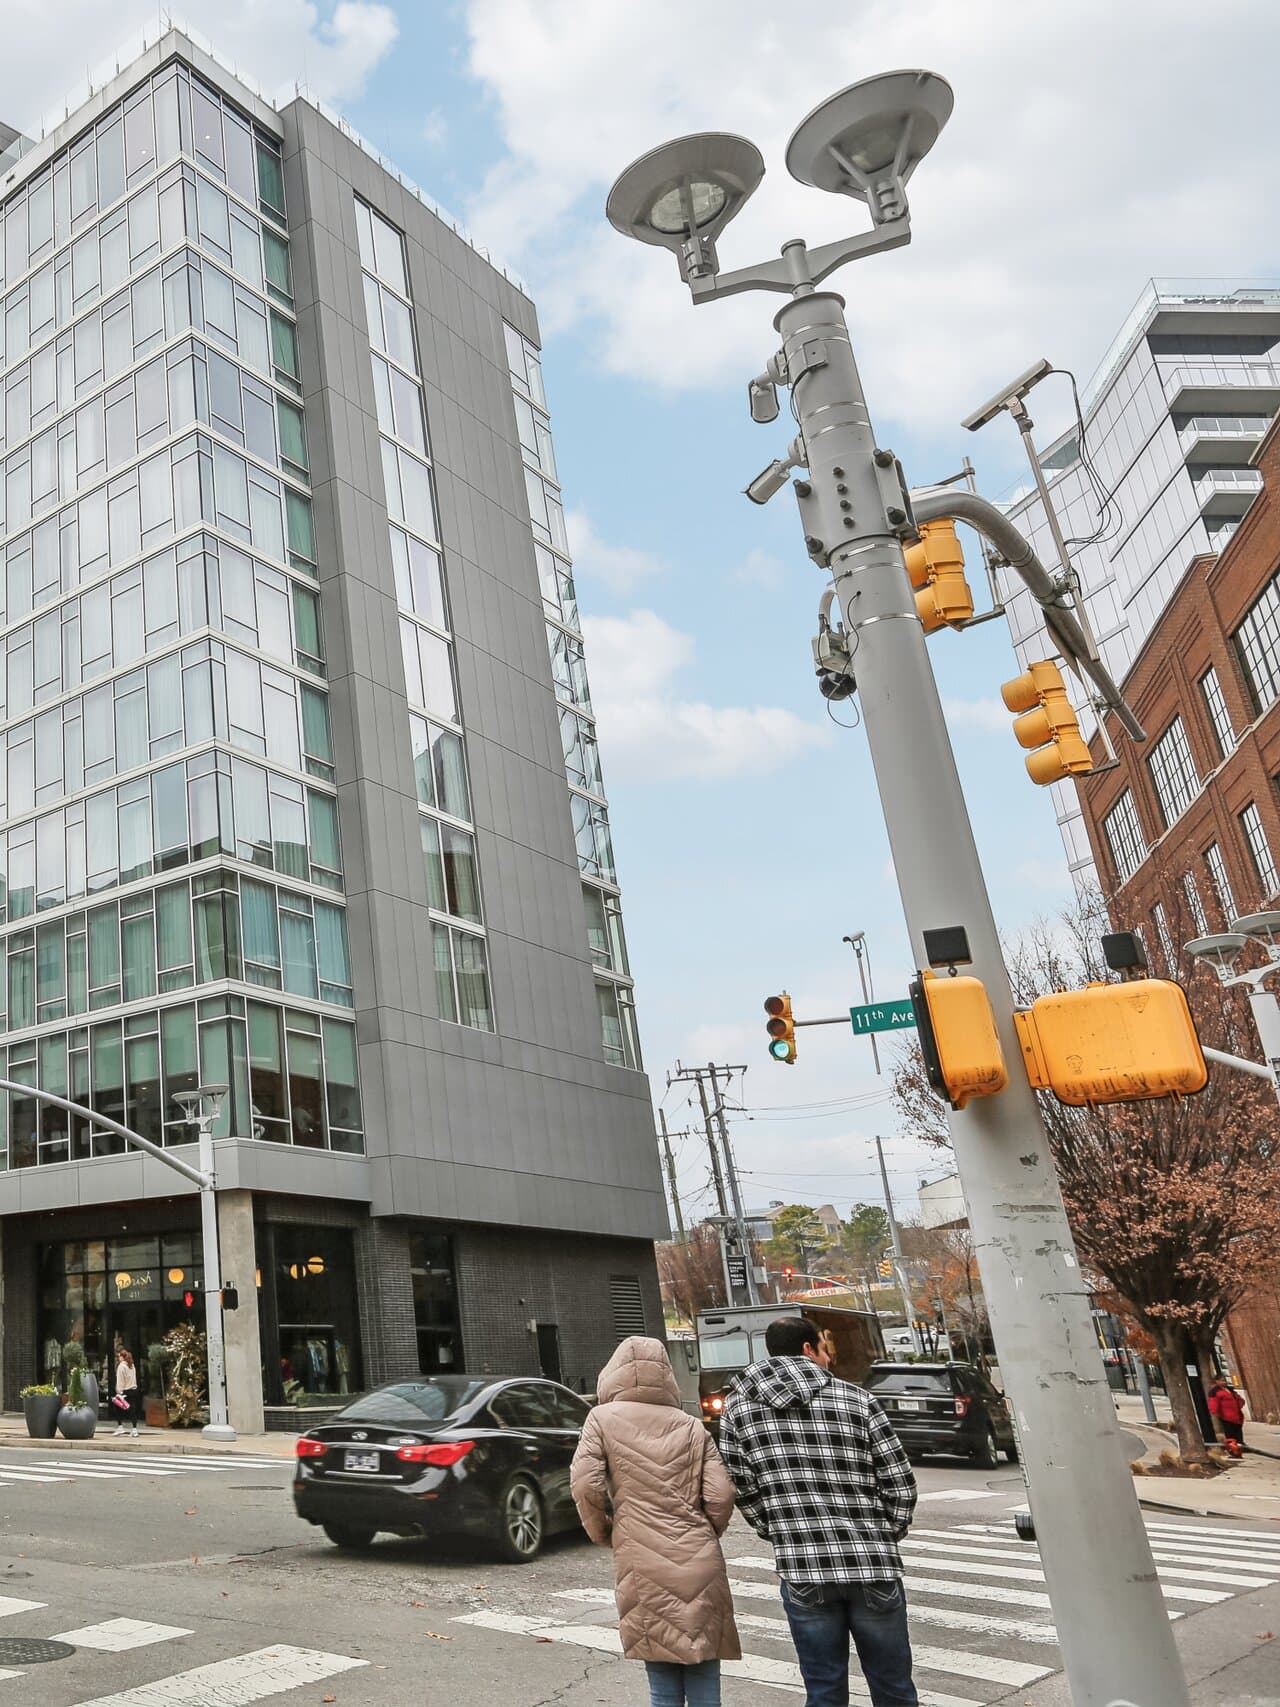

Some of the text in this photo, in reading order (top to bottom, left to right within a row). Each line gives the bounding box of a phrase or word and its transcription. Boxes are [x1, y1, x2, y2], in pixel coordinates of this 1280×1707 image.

[856, 1010, 914, 1028] 11th Ave
[809, 1288, 837, 1297] GULCH
